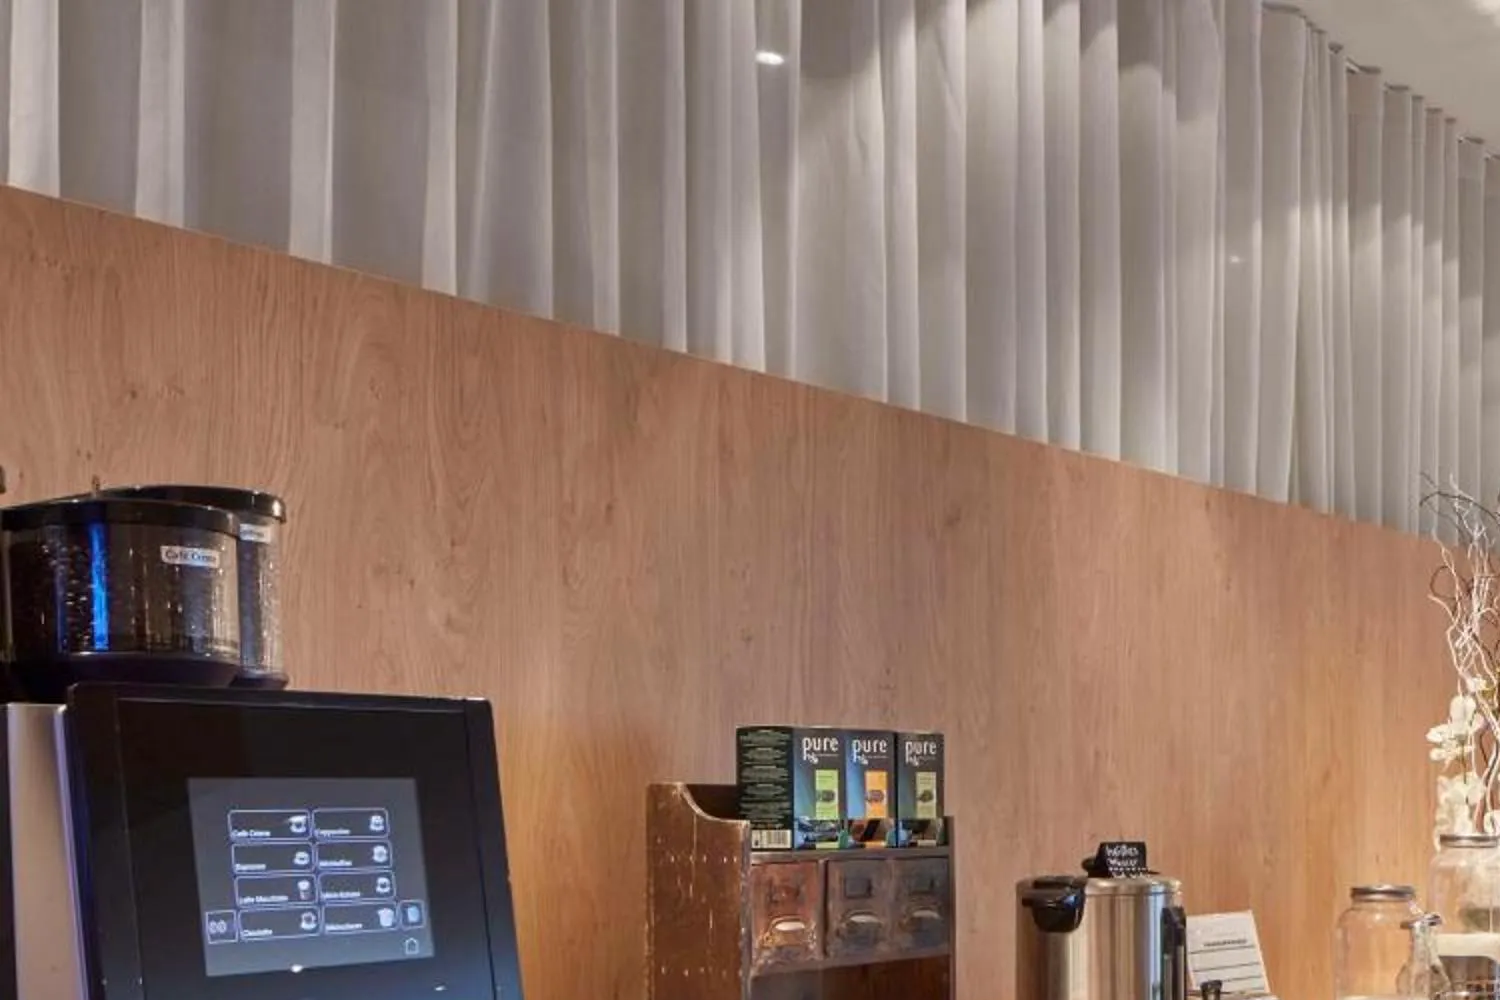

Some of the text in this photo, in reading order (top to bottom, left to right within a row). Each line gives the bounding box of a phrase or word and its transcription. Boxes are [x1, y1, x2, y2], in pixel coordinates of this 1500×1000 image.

[802, 736, 839, 760] pure
[852, 738, 888, 762] pure
[905, 740, 937, 763] pure
